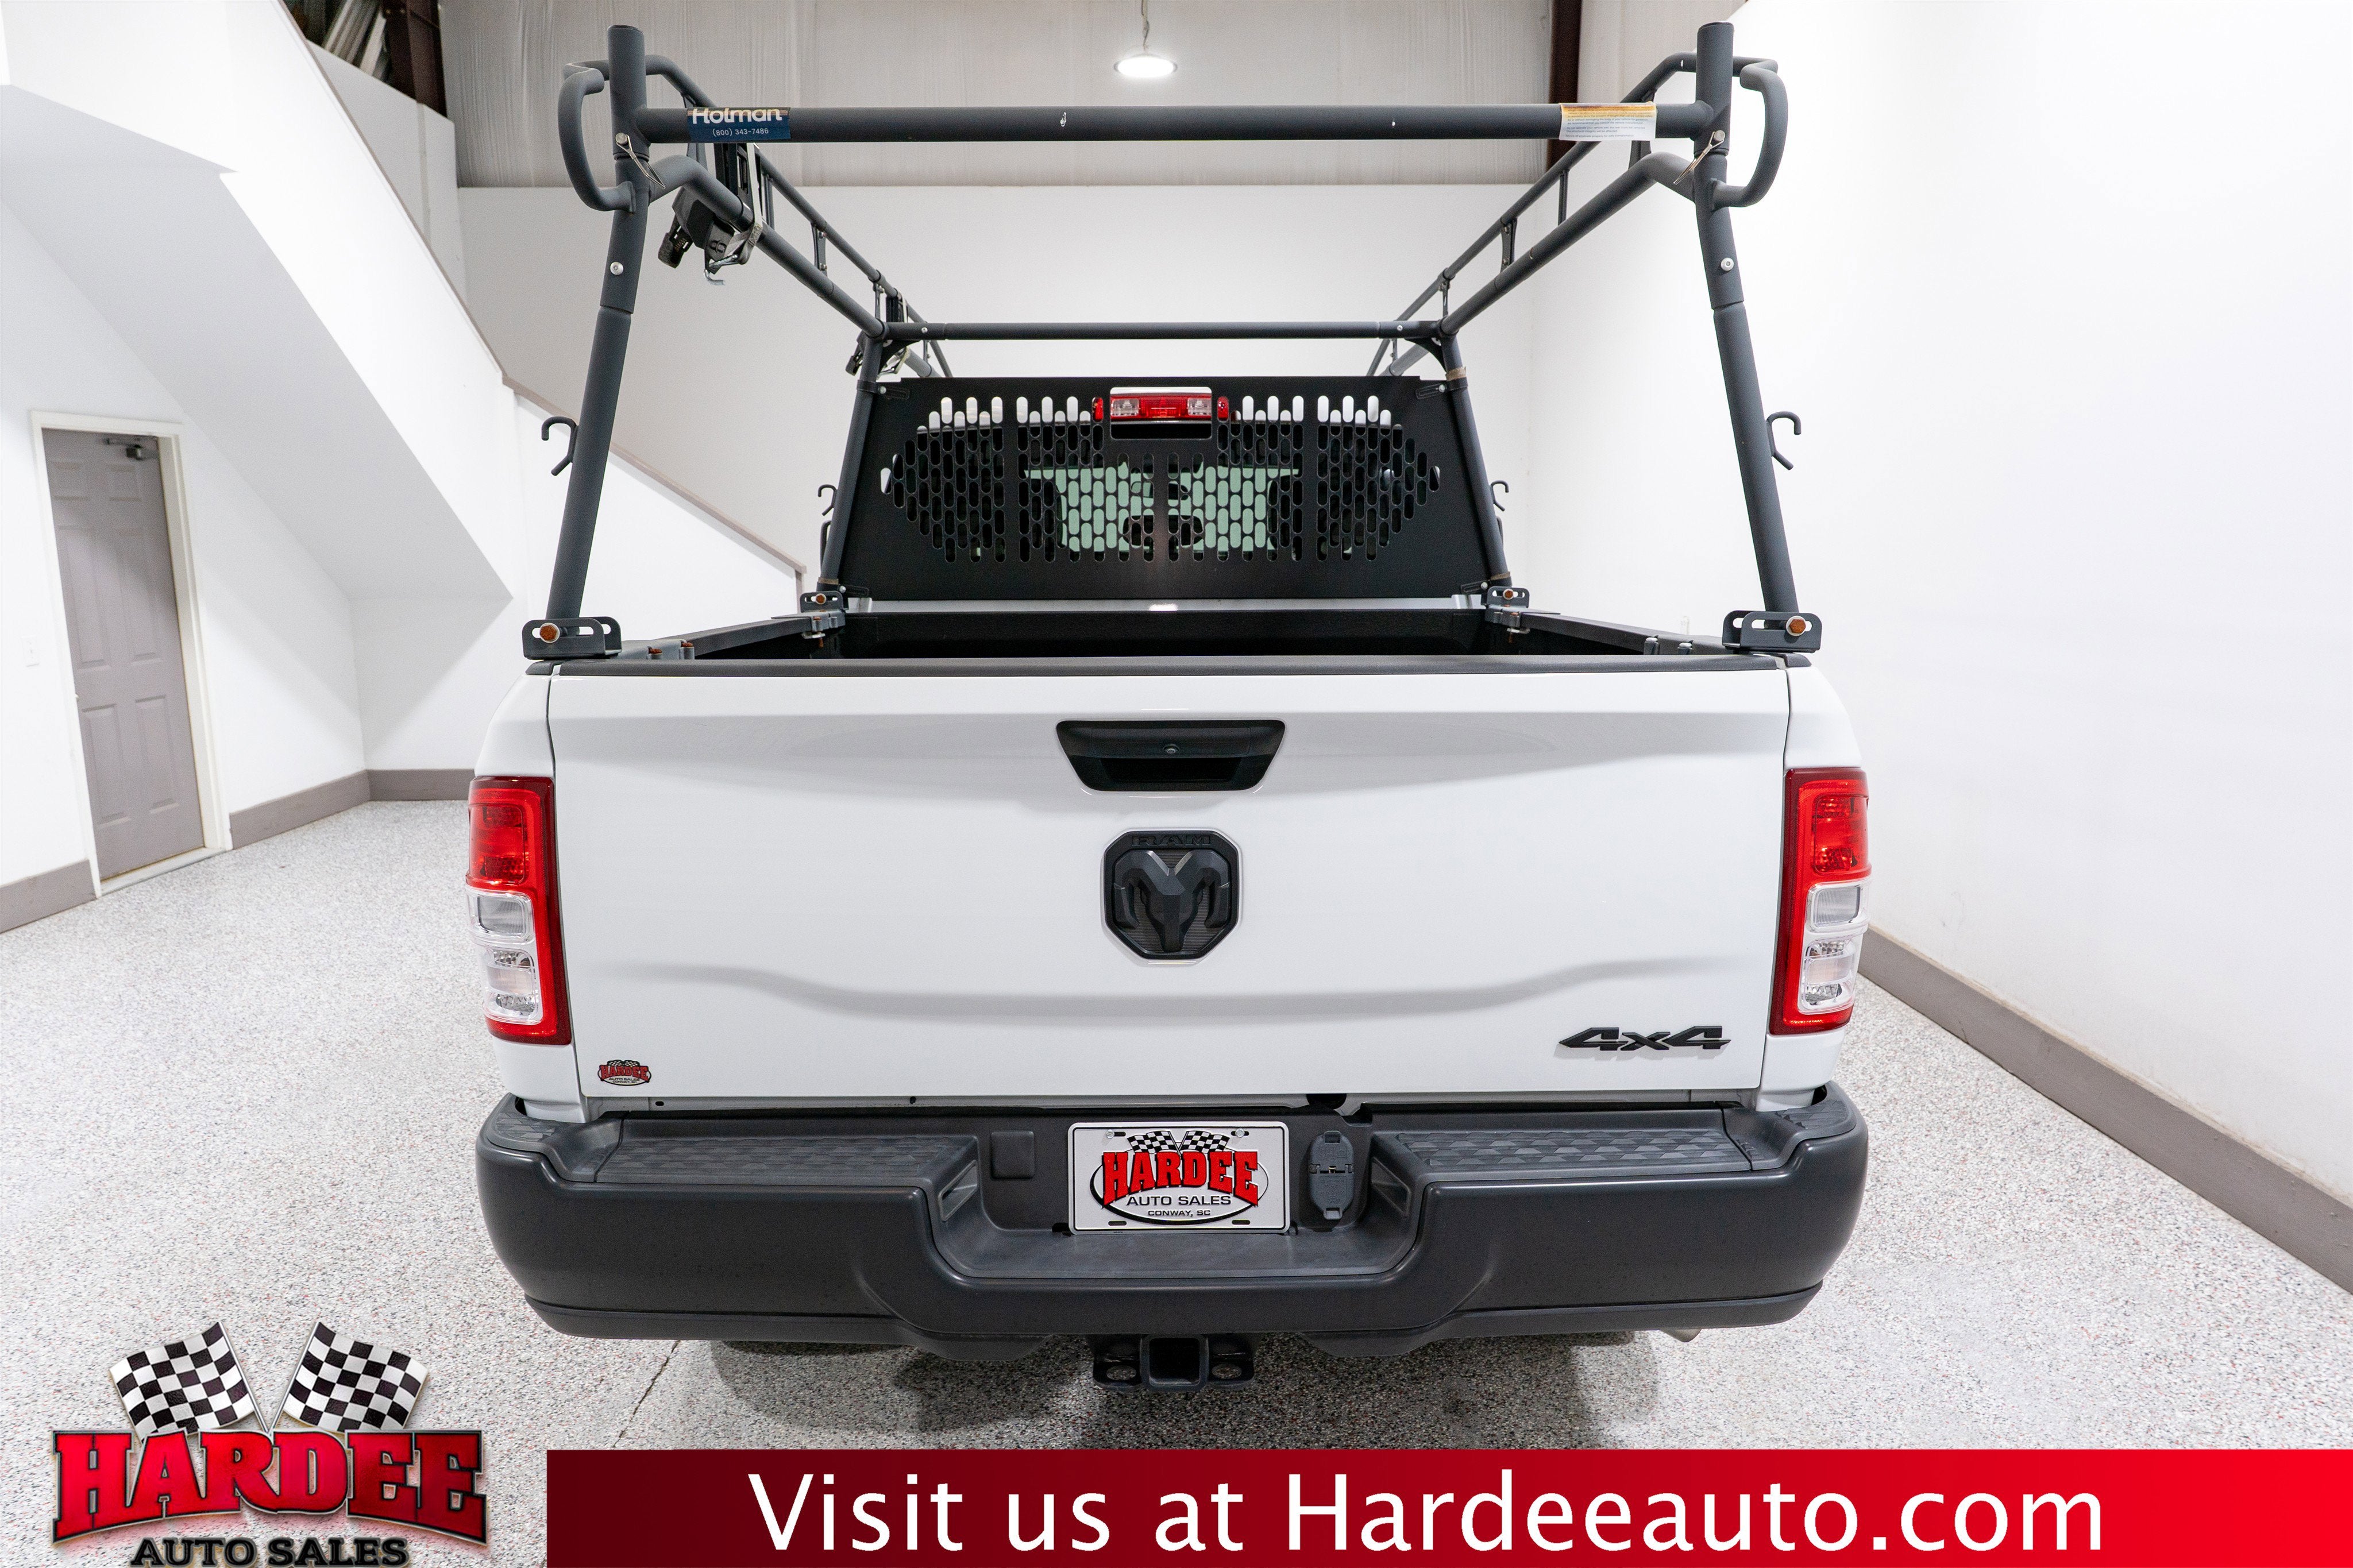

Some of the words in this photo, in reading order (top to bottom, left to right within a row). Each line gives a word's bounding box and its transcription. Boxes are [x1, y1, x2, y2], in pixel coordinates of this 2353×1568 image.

[693, 107, 782, 124] Holman
[712, 128, 732, 137] (800)
[1132, 835, 1211, 847] RAM
[1559, 1026, 1731, 1051] 4x4
[599, 1065, 649, 1082] HARDEE
[1102, 1151, 1259, 1208] HARDEE
[1127, 1196, 1172, 1206] AUTO
[1178, 1196, 1231, 1205] SALES
